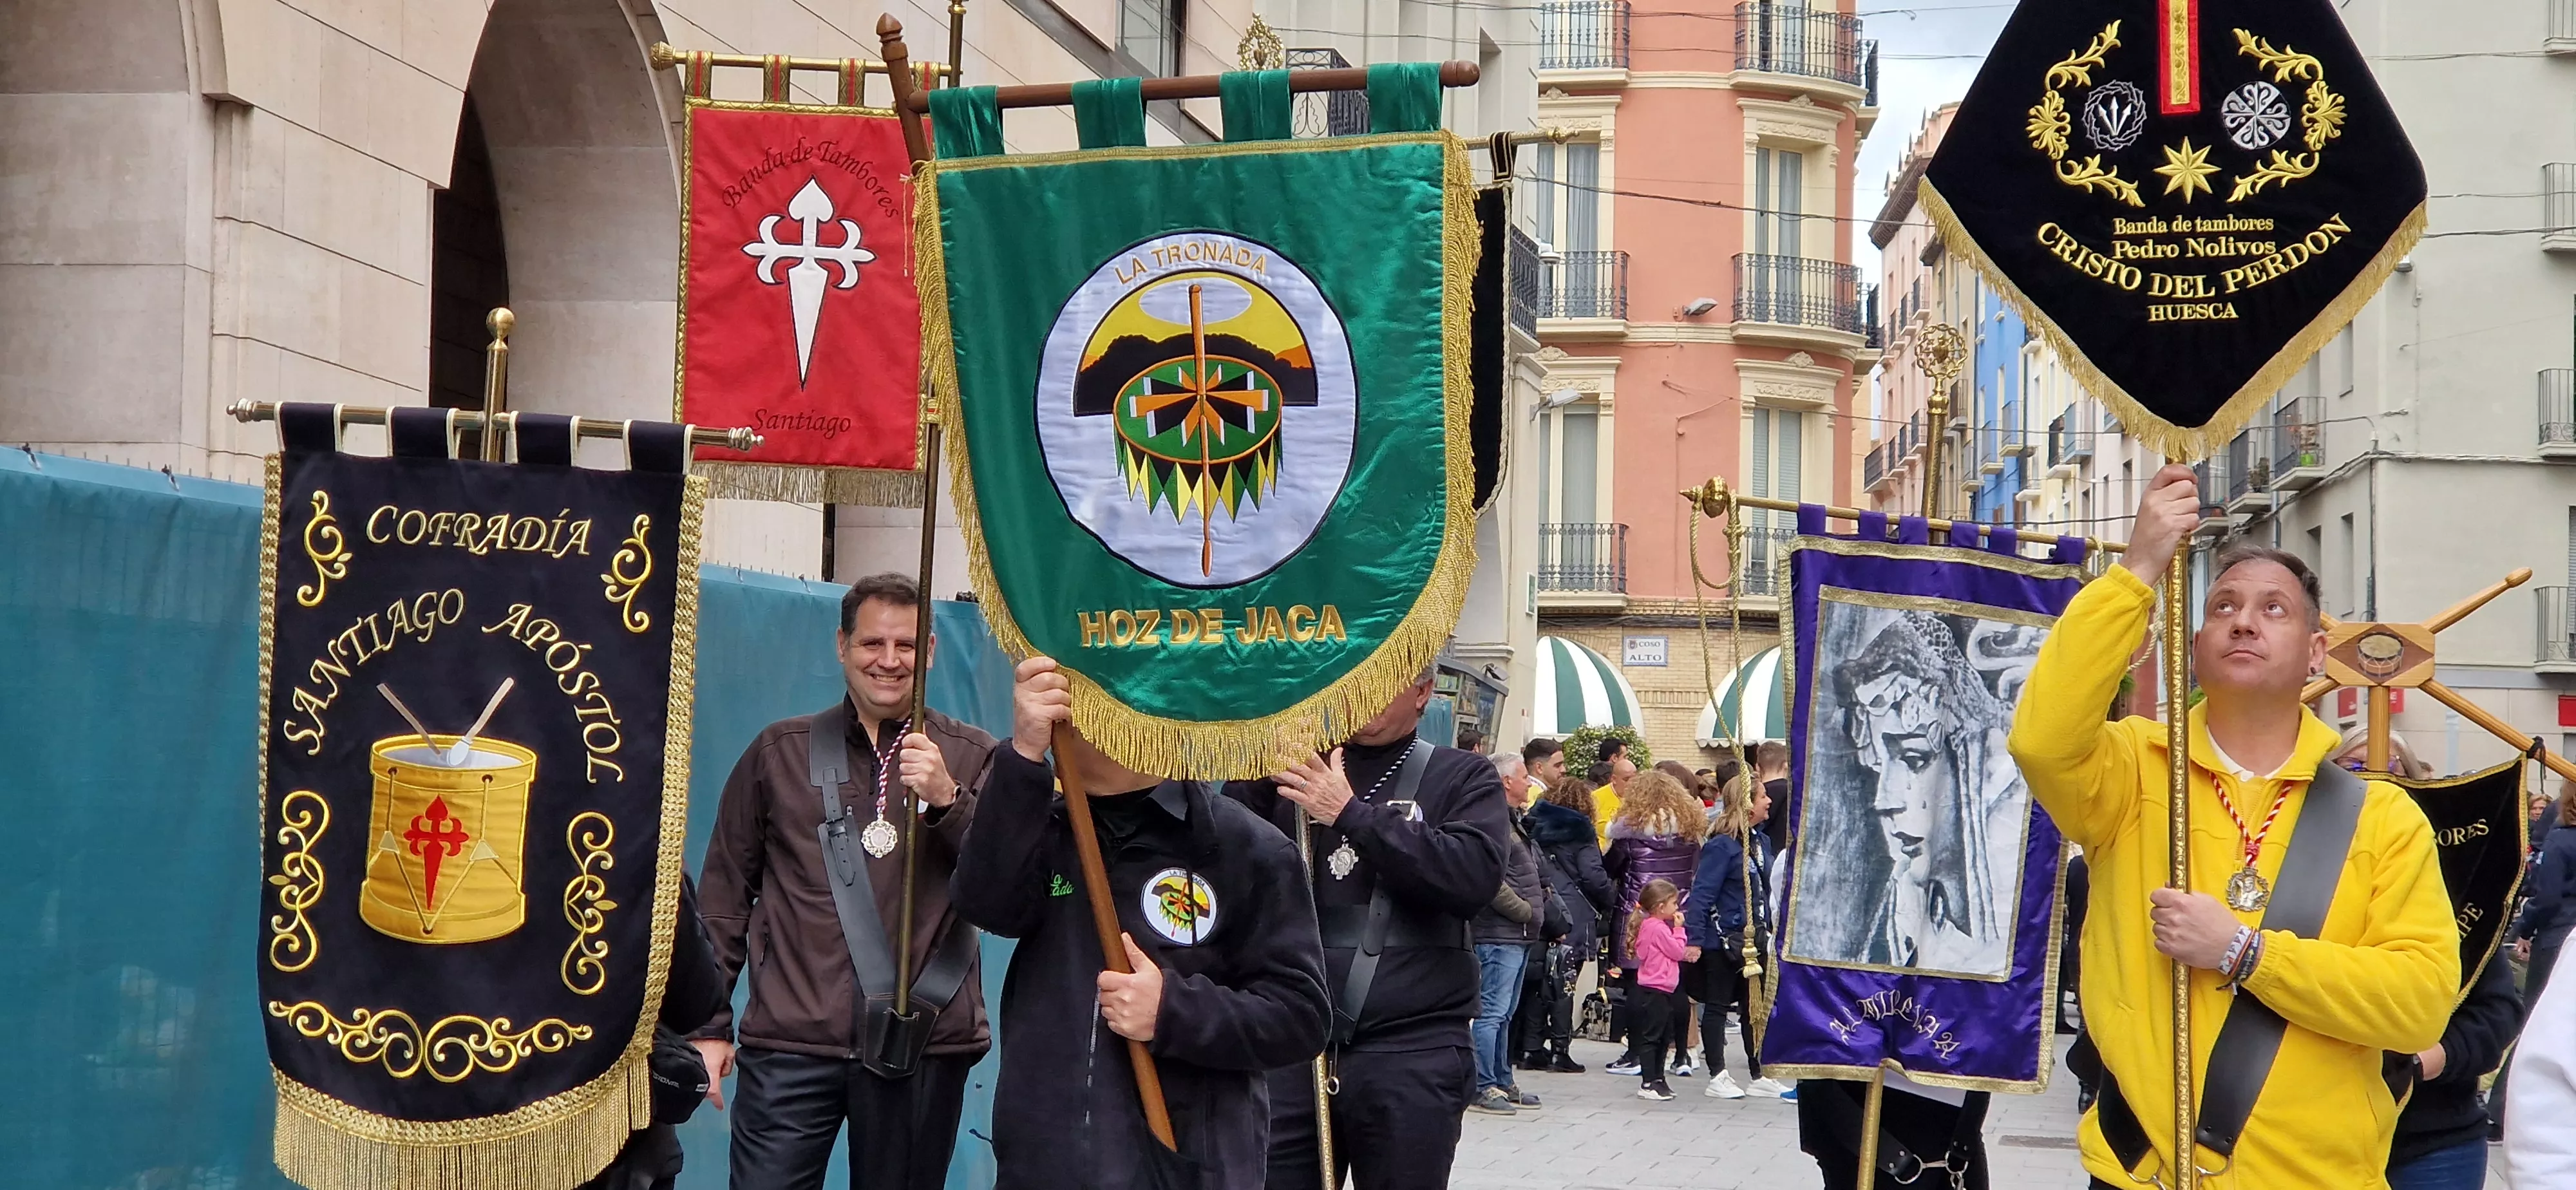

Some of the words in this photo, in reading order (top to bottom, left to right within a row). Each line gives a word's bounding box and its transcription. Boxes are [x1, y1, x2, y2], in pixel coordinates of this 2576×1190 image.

[723, 146, 785, 209] Banda
[789, 137, 813, 163] de
[817, 140, 898, 218] Tambores
[2112, 215, 2168, 235] Banda
[2172, 215, 2192, 233] de
[2196, 214, 2274, 232] tambores
[1114, 255, 1148, 285] LA
[1150, 241, 1267, 275] TRONADA
[2036, 222, 2142, 291] CRISTO
[2147, 273, 2215, 299] DEL
[2221, 212, 2353, 295] PERDON
[2111, 238, 2179, 260] Pedro
[2185, 236, 2276, 258] Nolivos
[2147, 302, 2239, 322] HUESCA
[750, 408, 851, 439] Santiago
[366, 505, 591, 559] COFRADÍA
[1077, 609, 1162, 648] HOZ
[1170, 609, 1224, 646] DE
[1235, 605, 1347, 646] JACA
[283, 588, 464, 756] SANTIAGO
[481, 603, 625, 784] APÓSTOL
[2434, 818, 2490, 847] ORES
